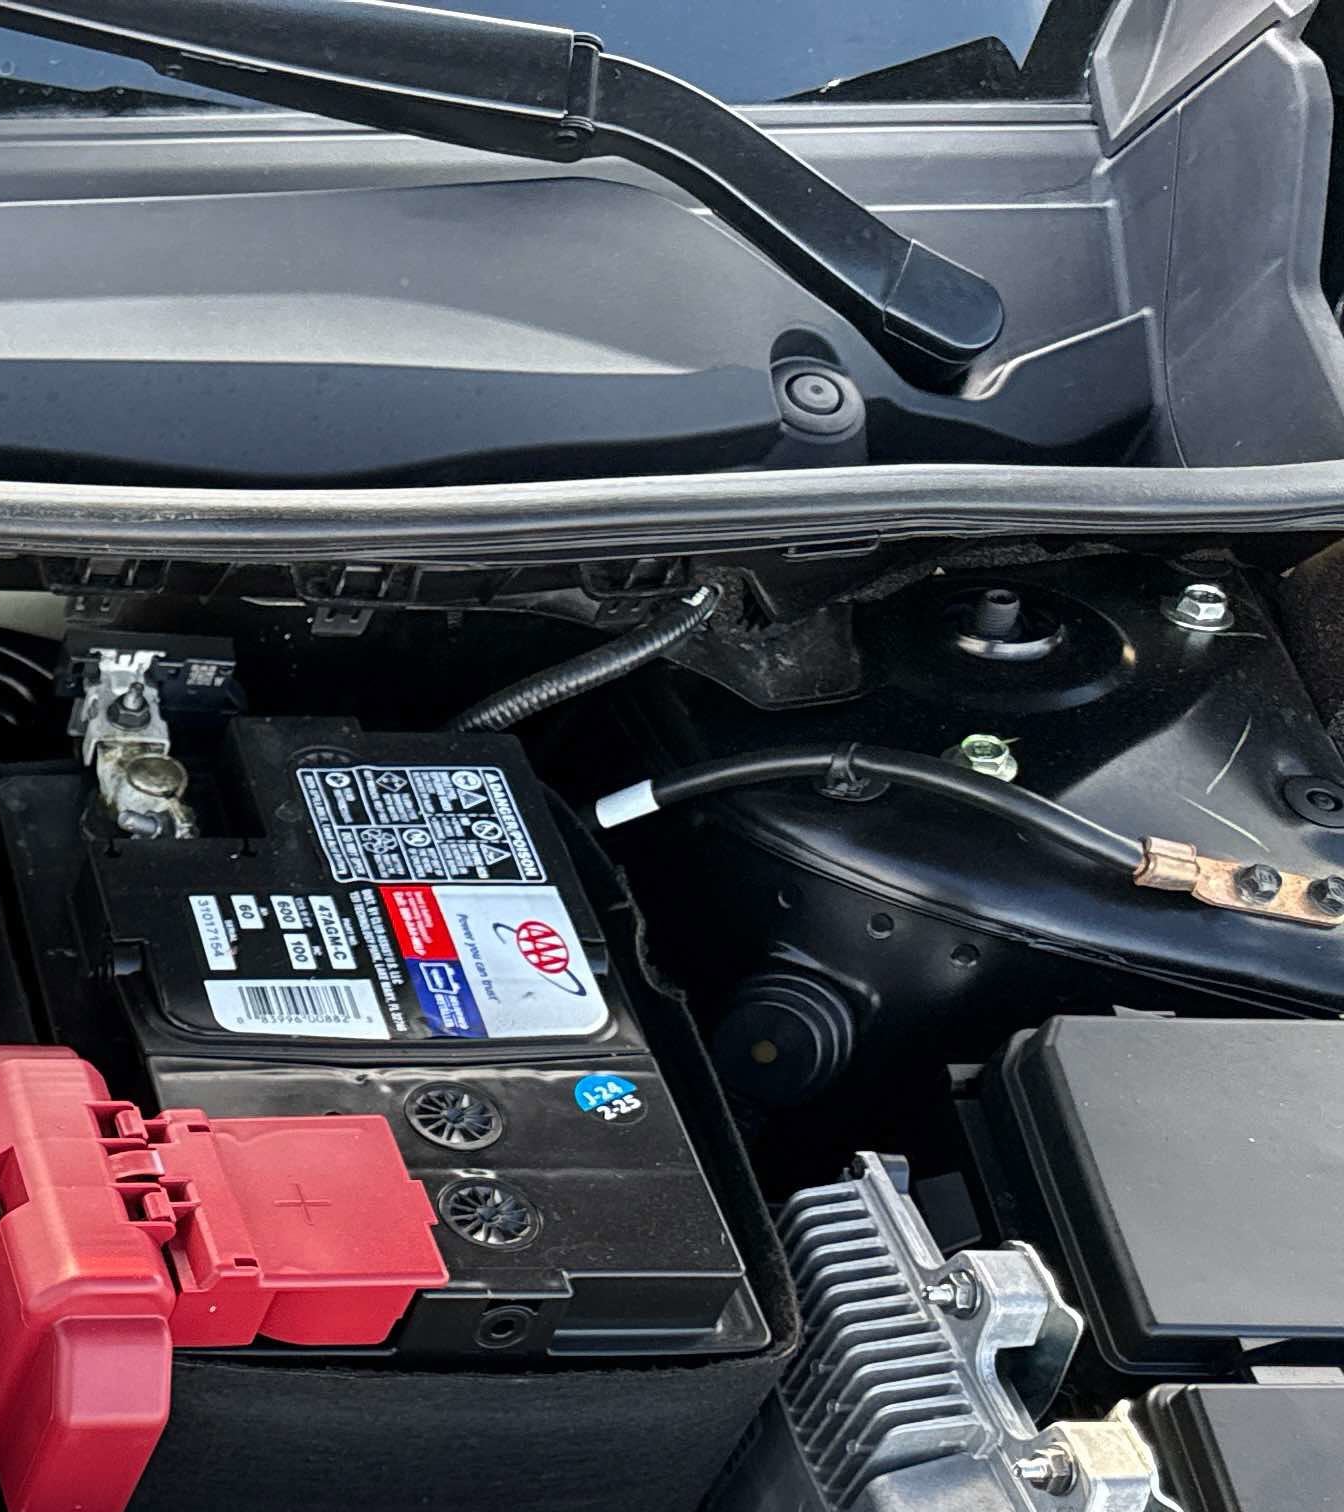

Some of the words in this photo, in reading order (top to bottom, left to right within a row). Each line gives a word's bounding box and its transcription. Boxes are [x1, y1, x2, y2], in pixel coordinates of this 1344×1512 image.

[239, 904, 255, 919] 60
[277, 900, 295, 923] 600
[198, 899, 224, 957] 31017154
[317, 904, 347, 961] 47AGM-C
[455, 913, 476, 941] Power
[292, 941, 308, 962] 100
[464, 942, 482, 960] you
[518, 923, 568, 971] AAA
[475, 961, 489, 978] can
[596, 1094, 641, 1121] 2-25
